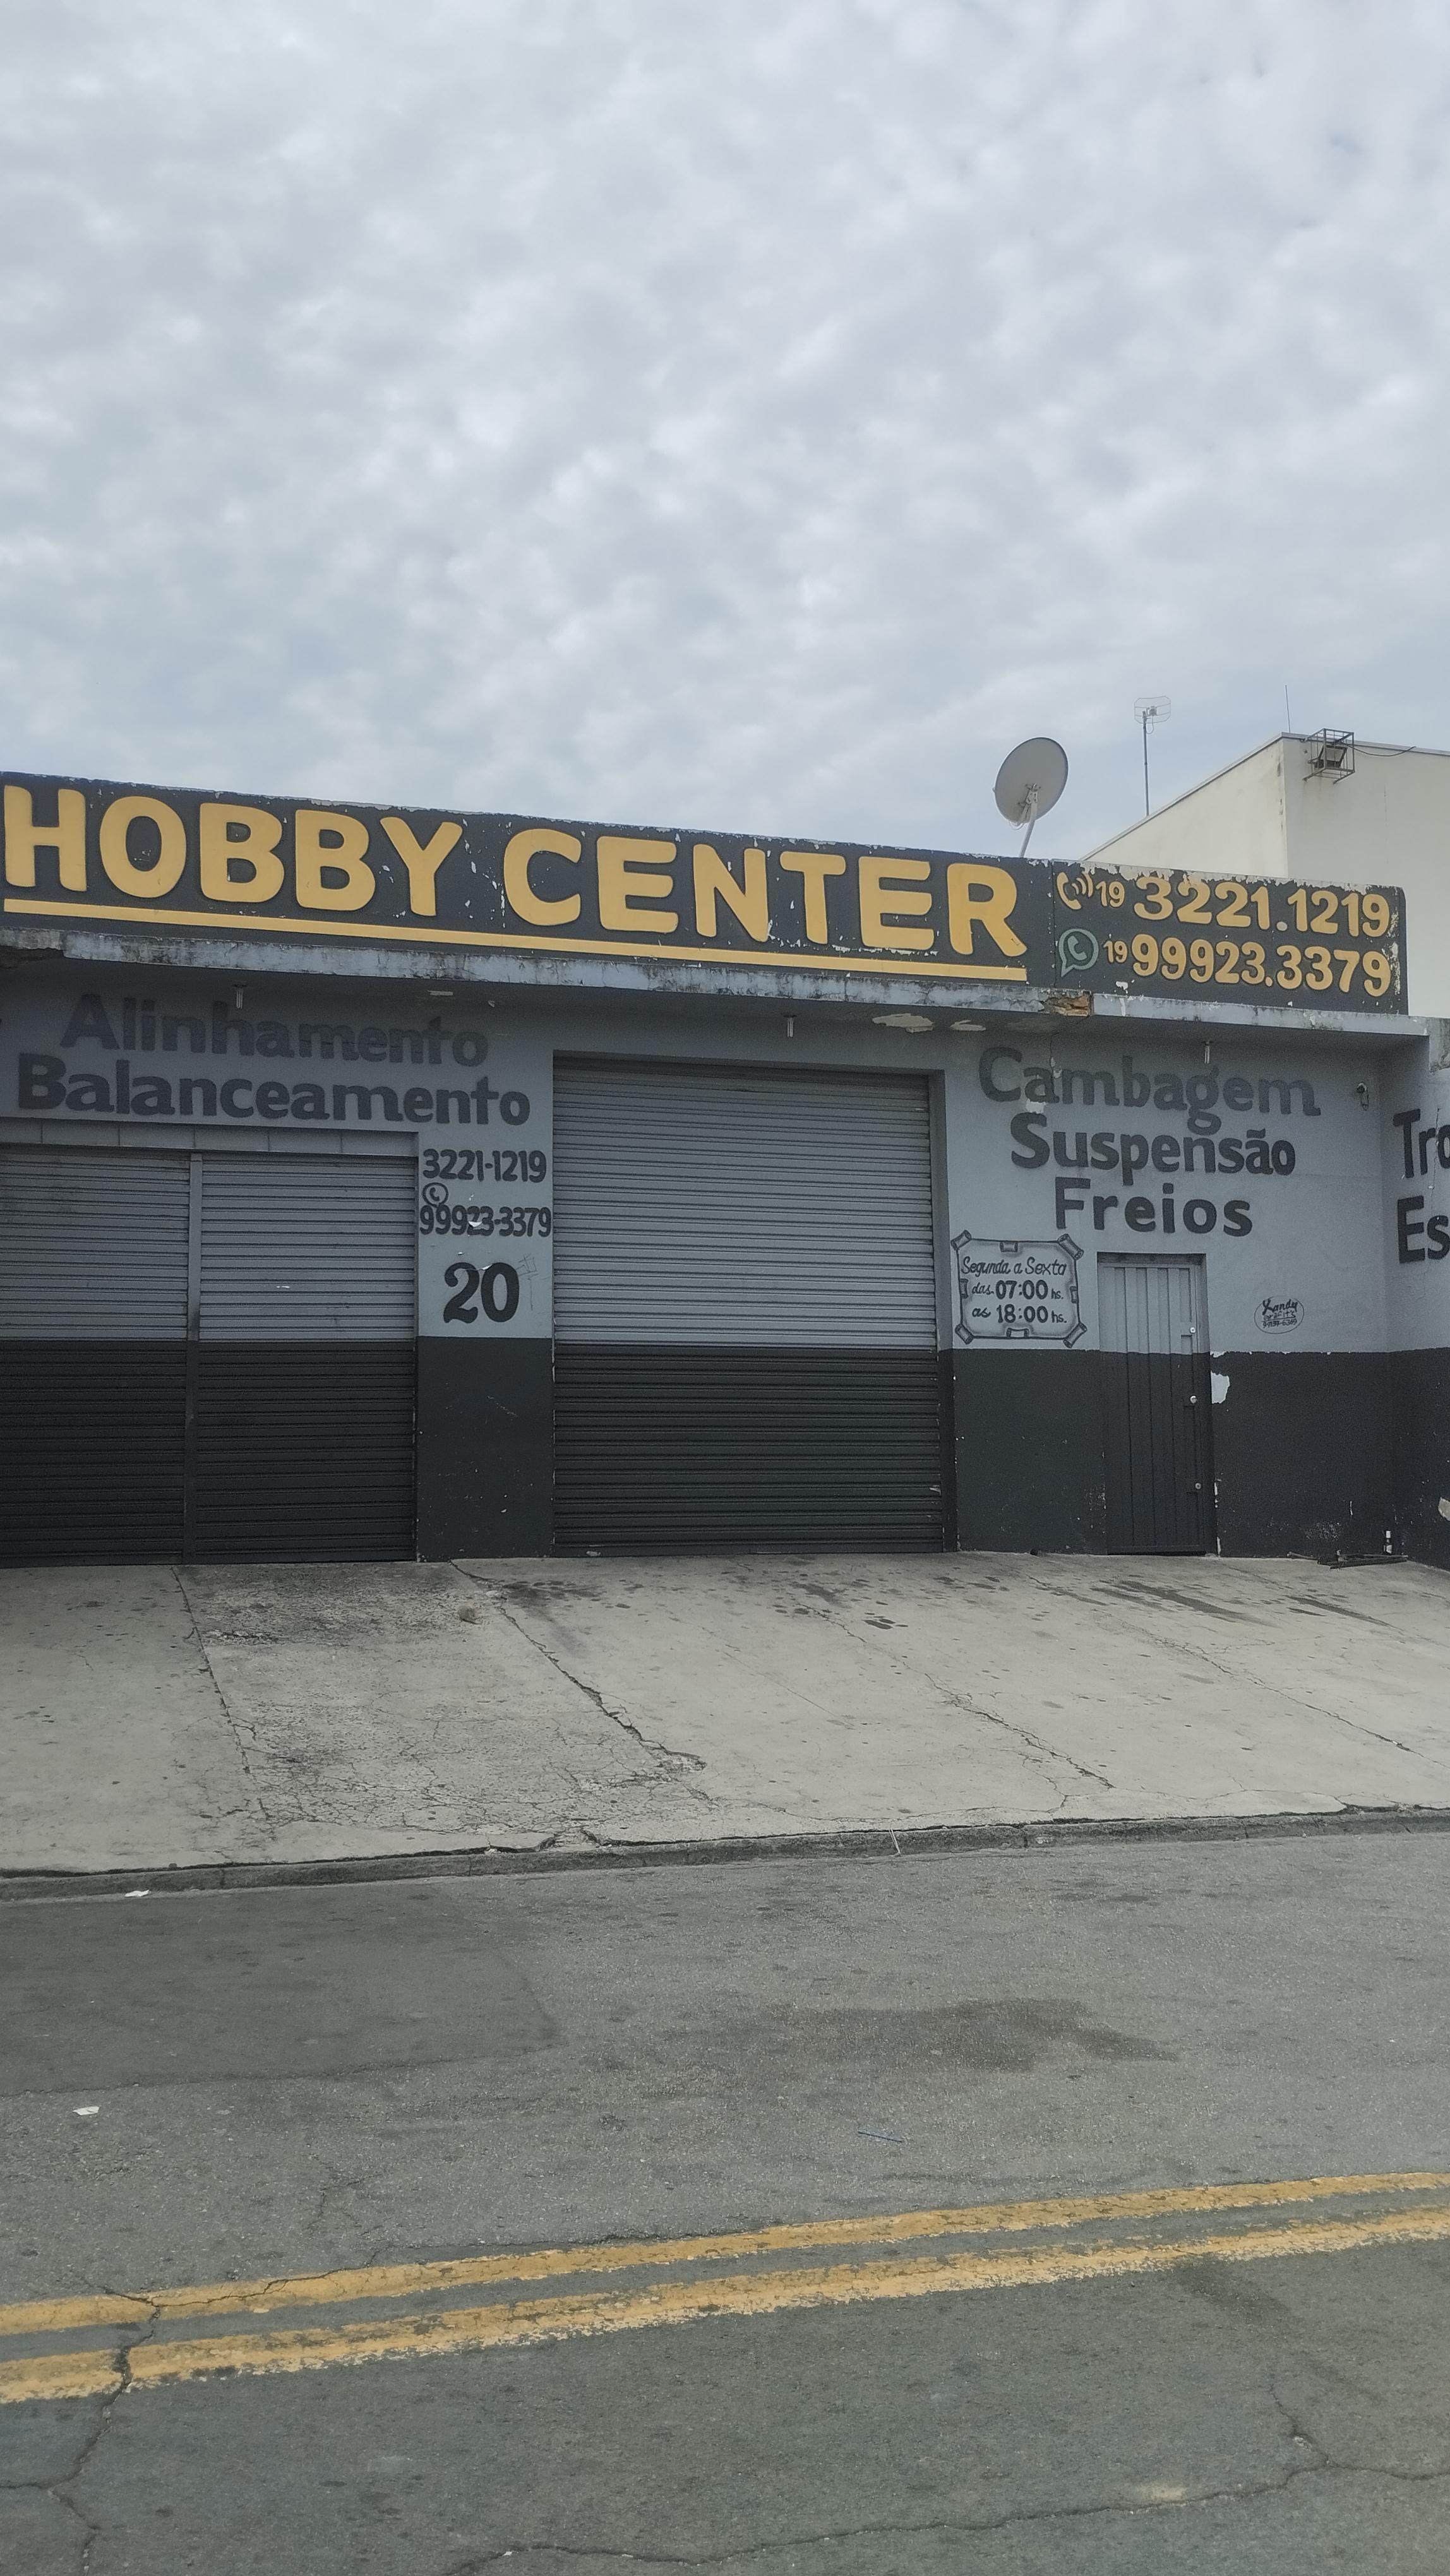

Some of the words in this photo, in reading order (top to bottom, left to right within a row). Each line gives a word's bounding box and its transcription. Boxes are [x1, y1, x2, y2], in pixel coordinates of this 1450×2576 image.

[3, 785, 464, 917] HOBBY
[503, 828, 1028, 957] CENTER
[1096, 880, 1125, 908] 19
[1134, 876, 1389, 937] 3221.1219
[1103, 939, 1128, 963] 19
[1132, 933, 1390, 997] 99923.3379
[60, 993, 489, 1067] Alinhamento
[18, 1052, 530, 1126] Balanceamento
[978, 1046, 1321, 1135] Cambagem
[422, 1148, 547, 1183] 3221-1219
[1010, 1112, 1296, 1186] Suspensão
[419, 1204, 551, 1237] 99923-3379
[1055, 1176, 1253, 1237] Freios
[1397, 1195, 1450, 1263] Es
[443, 1262, 520, 1323] 20
[961, 1256, 1010, 1277] Segunda
[1014, 1262, 1022, 1274] a
[1024, 1256, 1067, 1275] Sexta
[995, 1280, 1048, 1300] 07:00
[1051, 1289, 1064, 1299] hs.
[972, 1307, 991, 1318] as
[996, 1304, 1048, 1323] 18:00
[1052, 1310, 1067, 1323] hs.
